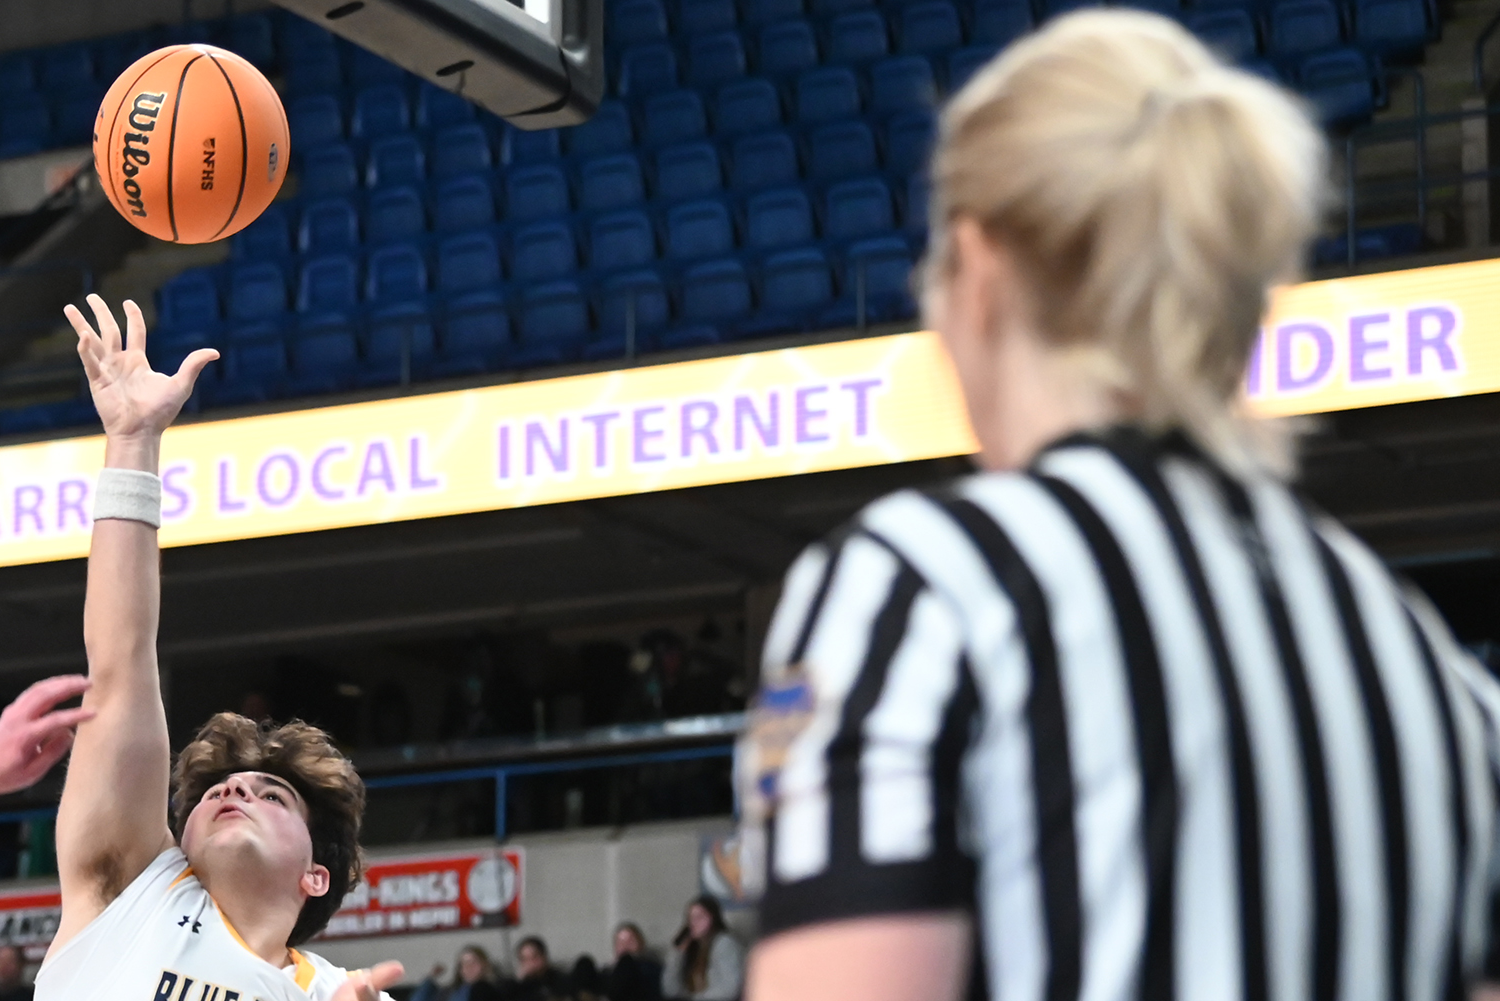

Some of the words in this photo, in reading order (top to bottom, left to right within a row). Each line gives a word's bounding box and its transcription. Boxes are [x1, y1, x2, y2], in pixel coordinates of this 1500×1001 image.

[122, 91, 167, 218] Wilson
[201, 150, 215, 191] NFHS
[217, 436, 438, 512] LOCAL
[499, 378, 883, 480] INTERNET
[1245, 305, 1459, 396] IDER
